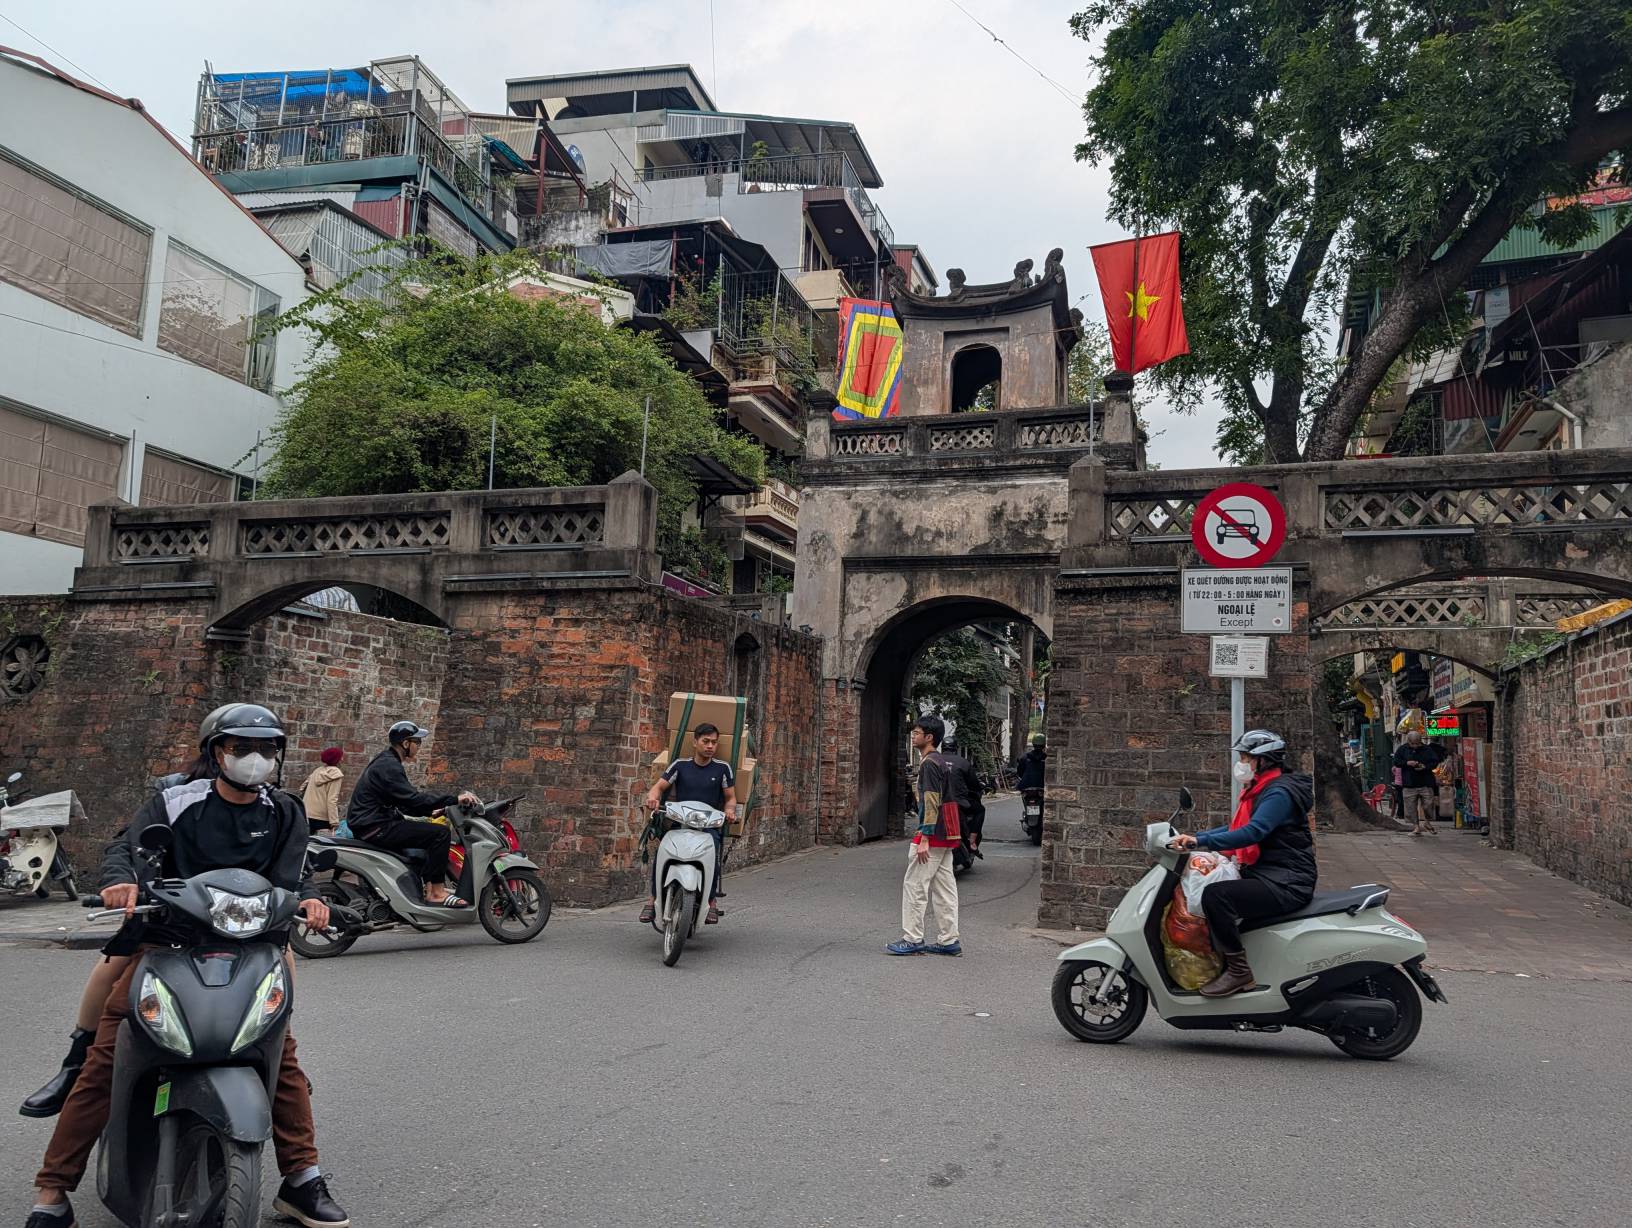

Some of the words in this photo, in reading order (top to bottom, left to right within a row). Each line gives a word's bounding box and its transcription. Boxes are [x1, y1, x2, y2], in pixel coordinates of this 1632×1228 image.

[1188, 577, 1195, 585] XE
[1254, 576, 1269, 586] HOẠT
[1218, 604, 1243, 616] NGOẠI
[1246, 602, 1255, 616] LỆ
[1220, 617, 1253, 628] Except
